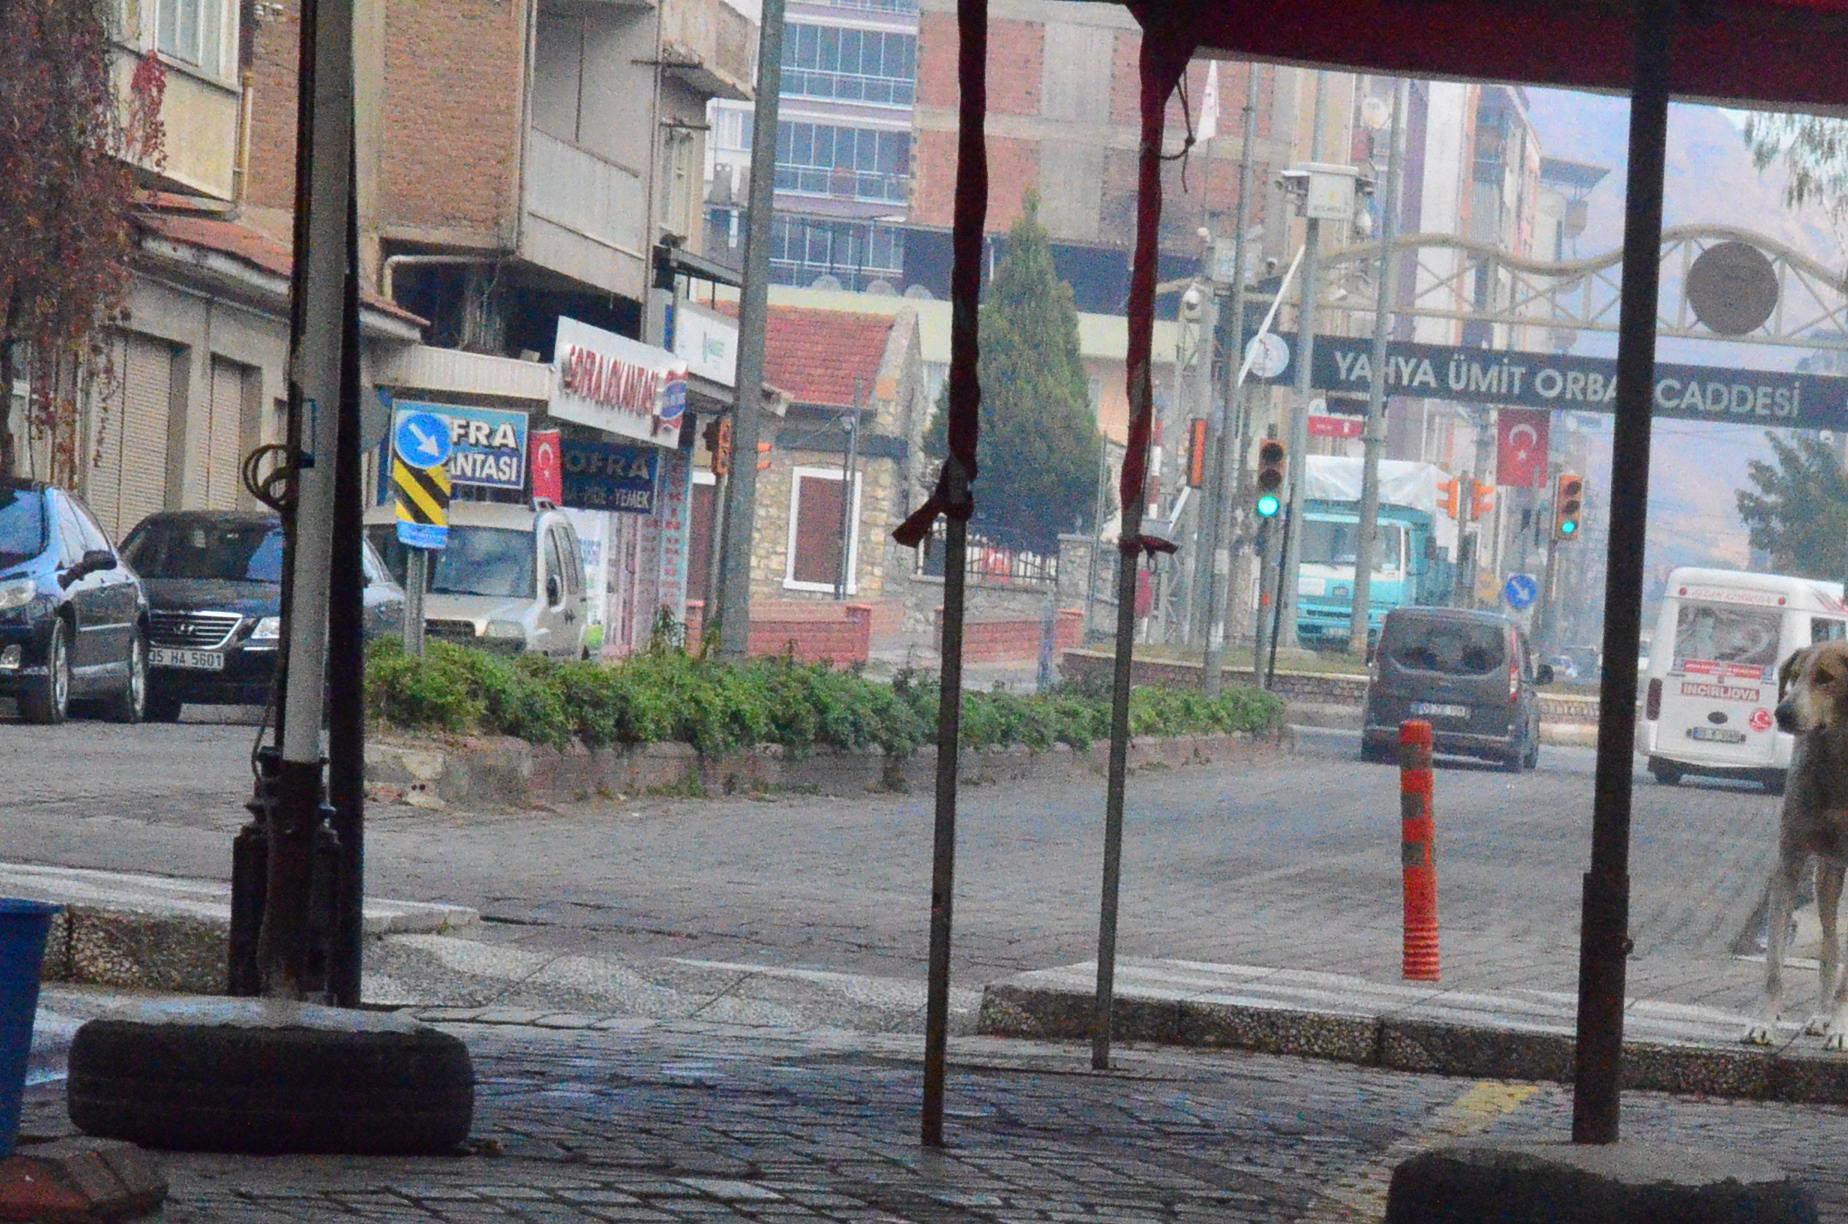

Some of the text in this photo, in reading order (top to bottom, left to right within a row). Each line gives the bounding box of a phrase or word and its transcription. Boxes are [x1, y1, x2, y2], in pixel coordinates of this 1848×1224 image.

[1334, 350, 1437, 388] YAHYA
[1448, 355, 1526, 395] ÜMİT
[1655, 378, 1800, 418] CADDESİ
[565, 450, 650, 480] OFRA
[170, 651, 186, 664] HA
